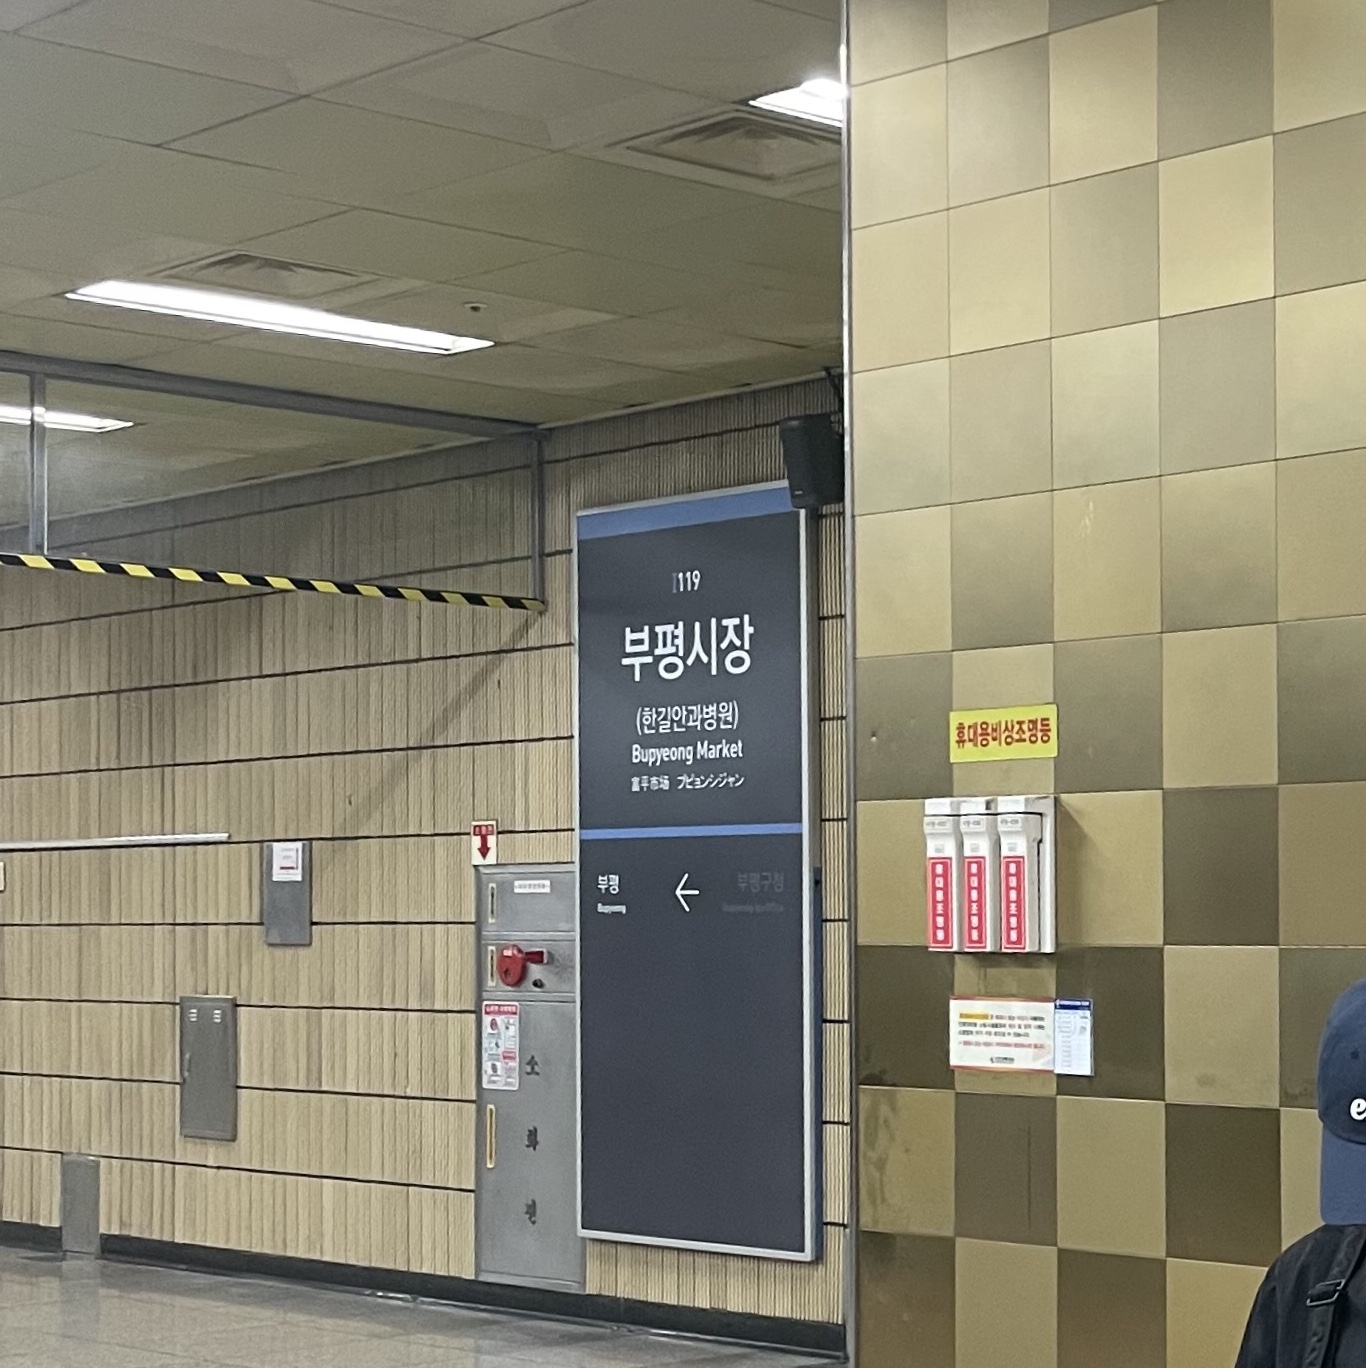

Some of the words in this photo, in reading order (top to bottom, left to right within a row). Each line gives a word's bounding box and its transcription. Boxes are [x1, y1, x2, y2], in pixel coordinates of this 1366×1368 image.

[621, 613, 755, 682] 부평시장
[636, 699, 739, 736] (한길안과병원)
[955, 717, 1052, 749] 휴대용비상조명등
[631, 743, 694, 767] Bupyeong
[696, 739, 744, 760] Market
[597, 874, 620, 895] 부평
